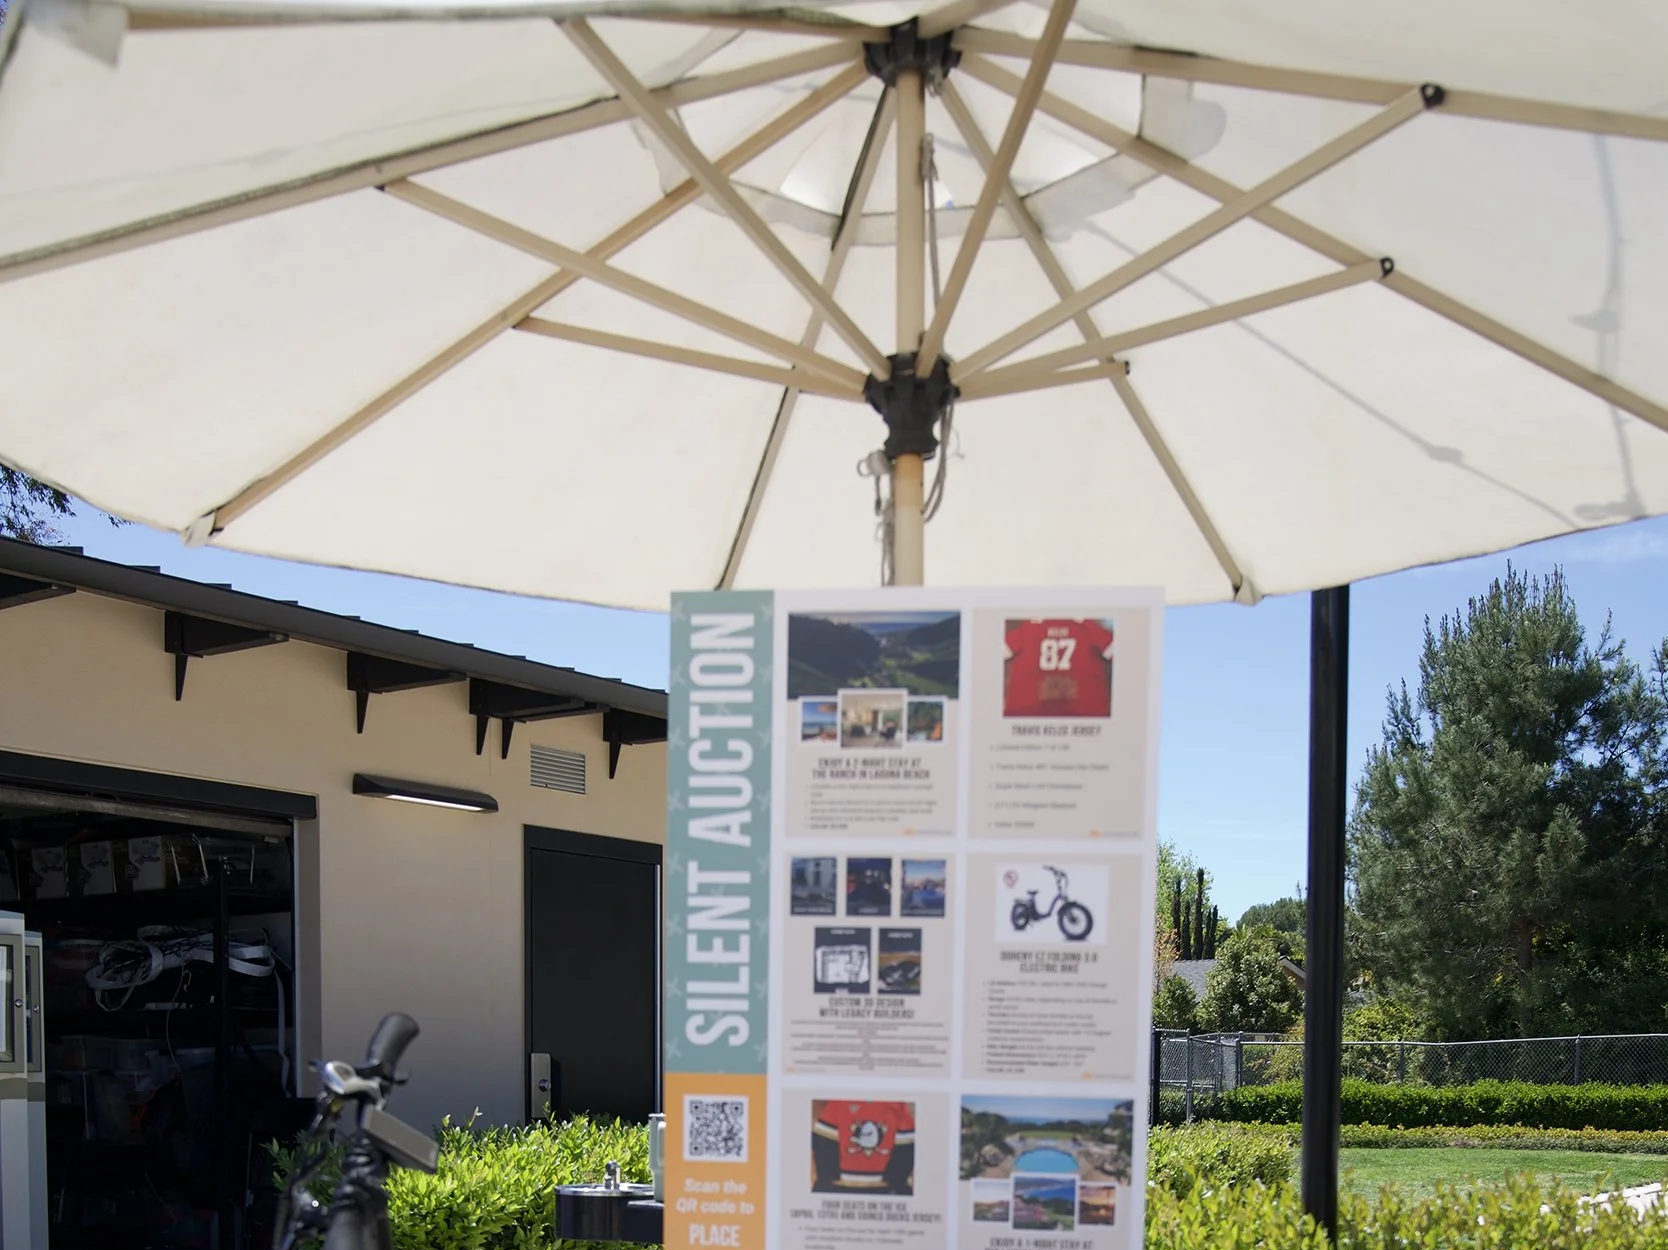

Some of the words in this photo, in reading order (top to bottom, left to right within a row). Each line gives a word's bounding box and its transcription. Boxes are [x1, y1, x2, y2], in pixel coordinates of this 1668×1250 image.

[1039, 638, 1076, 671] 87
[688, 613, 755, 848] AUCTION
[1012, 726, 1041, 736] TRAVIS
[1071, 726, 1102, 737] JERSEY
[818, 757, 842, 768] ENJOY
[888, 757, 909, 768] STAY
[911, 758, 922, 768] AT
[812, 769, 826, 779] THE
[829, 769, 856, 780] RANCH
[859, 769, 868, 780] IN
[869, 769, 901, 780] LAGUNA
[903, 769, 930, 780] BEACH
[685, 860, 752, 1047] SILENT
[1019, 963, 1058, 974] ELECTRIC
[1060, 963, 1079, 974] BIKE
[829, 997, 861, 1008] CUSTOM
[876, 997, 905, 1008] DESIGN
[819, 1008, 839, 1018] WITH
[841, 1008, 871, 1019] LEGACY
[684, 1177, 720, 1194] Scan
[723, 1179, 747, 1195] the
[675, 1197, 697, 1215] QR
[701, 1199, 736, 1214] code
[740, 1201, 755, 1215] to
[821, 1200, 840, 1210] FOUR
[842, 1201, 866, 1211] SEATS
[880, 1202, 893, 1212] THE
[688, 1223, 741, 1247] PLACE
[990, 1237, 1015, 1247] ENJOY
[1060, 1239, 1081, 1250] STAY
[1083, 1240, 1094, 1250] AT
